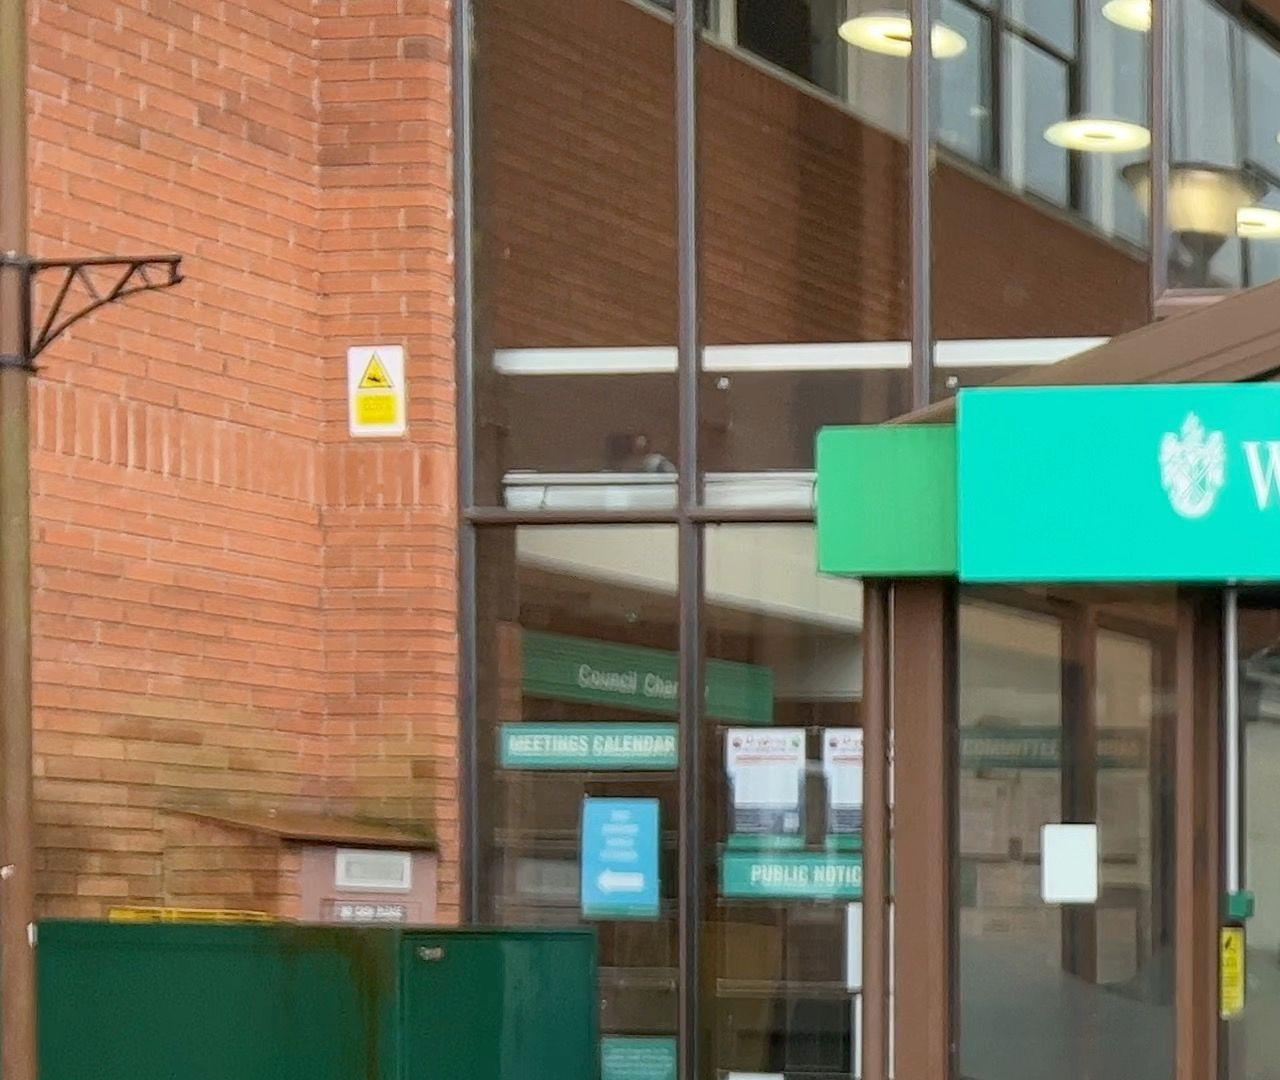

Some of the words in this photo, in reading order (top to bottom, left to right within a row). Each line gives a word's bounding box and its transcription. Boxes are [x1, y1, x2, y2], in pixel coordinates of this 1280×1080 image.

[577, 662, 638, 696] Council
[509, 735, 588, 755] MEETINGS
[592, 735, 677, 755] CALENDAR
[750, 864, 809, 886] PUBLIC
